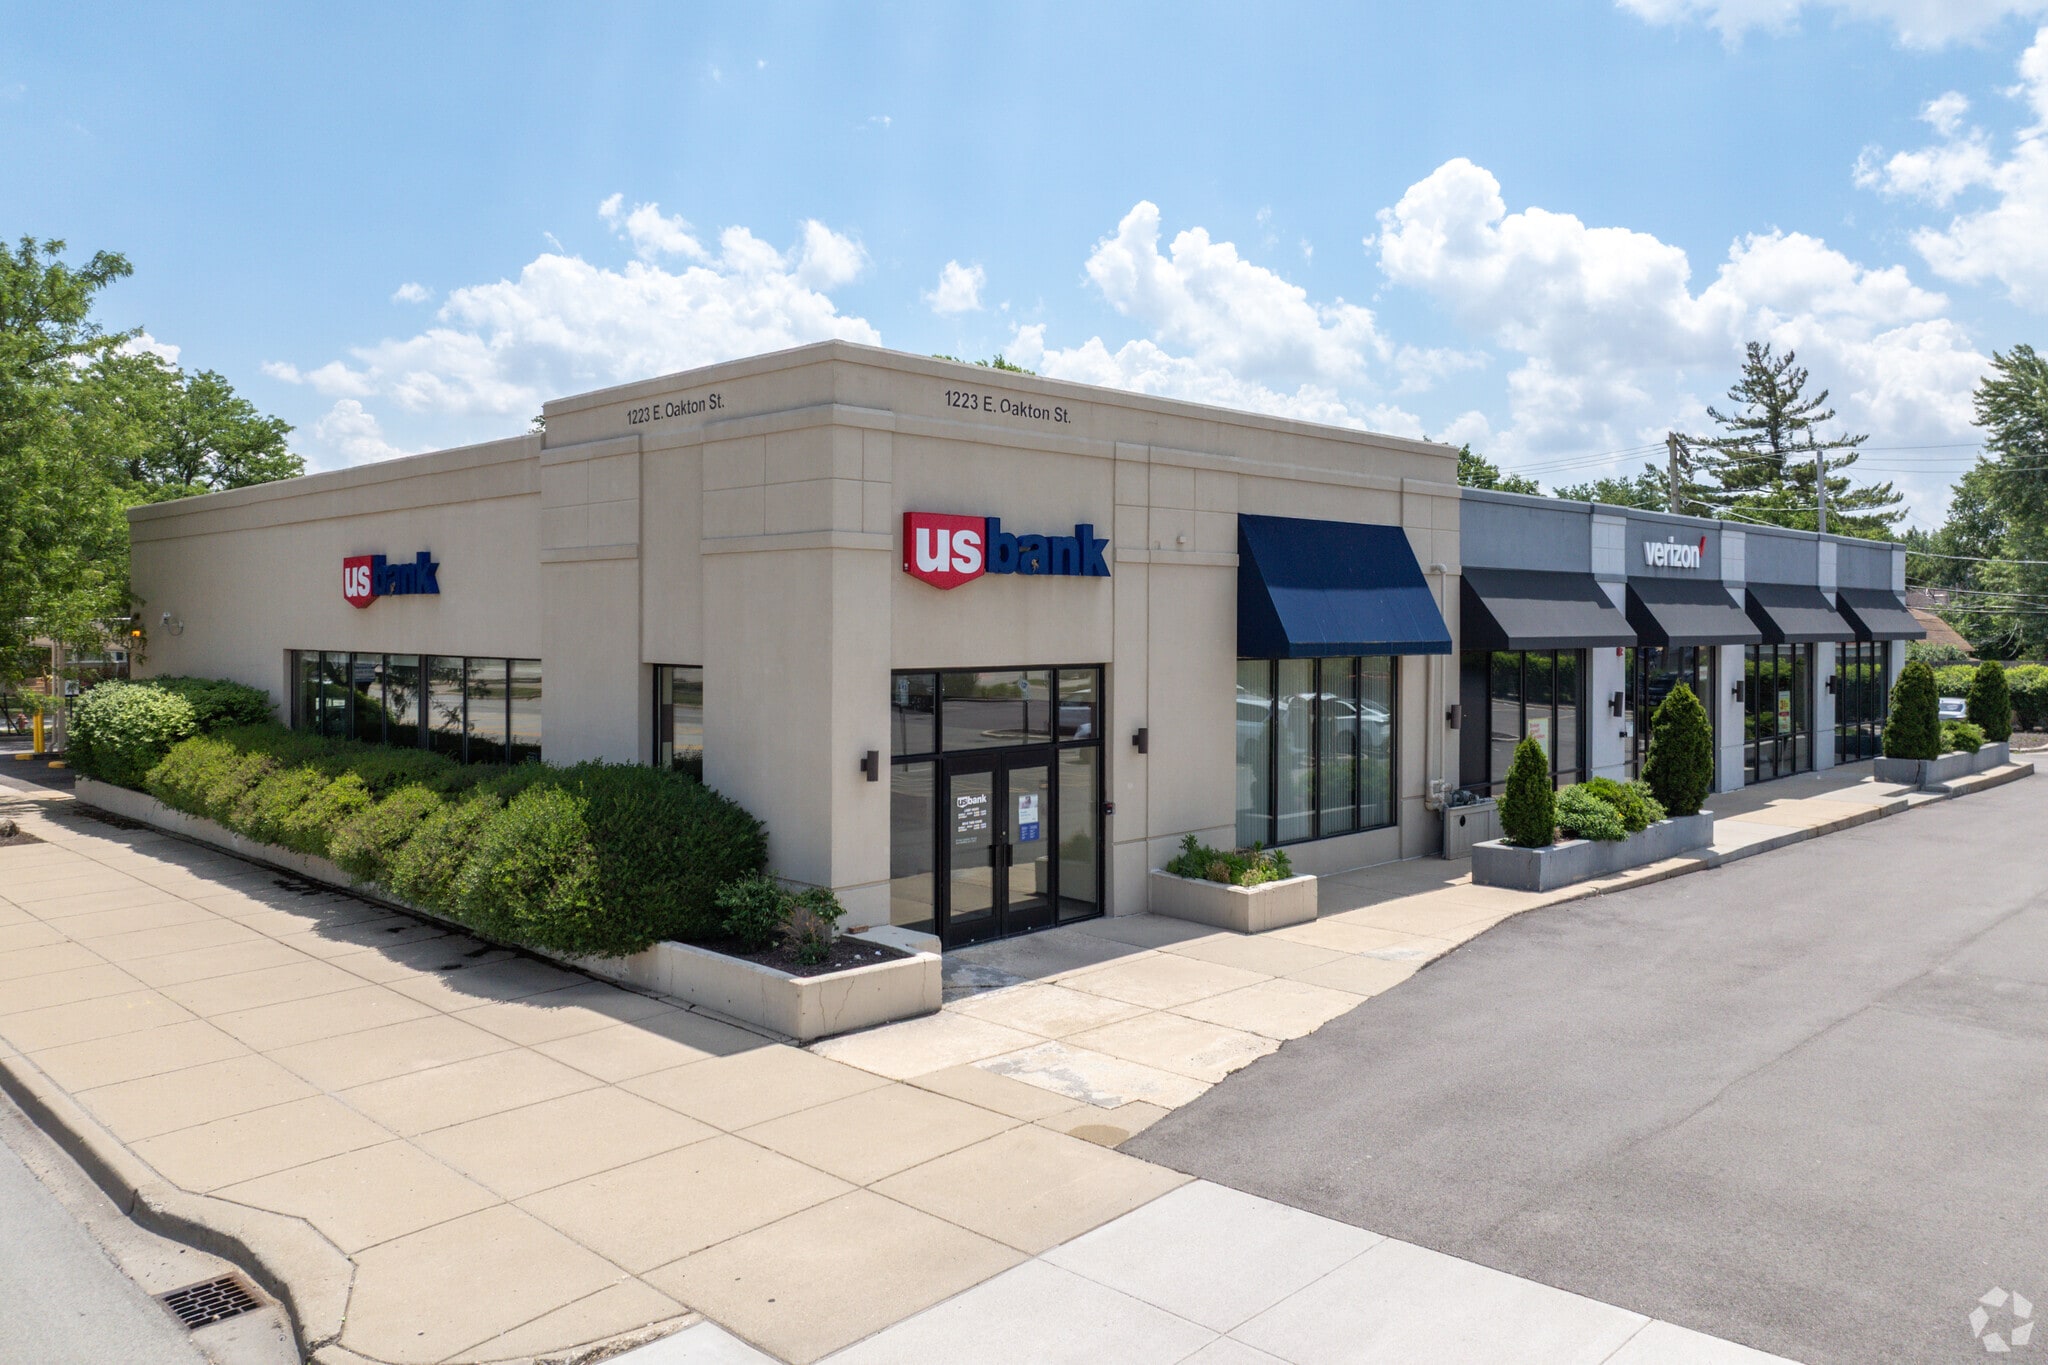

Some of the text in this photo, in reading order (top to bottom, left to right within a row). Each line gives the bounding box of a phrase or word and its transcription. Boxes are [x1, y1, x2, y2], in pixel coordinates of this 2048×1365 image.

[627, 393, 725, 425] 1223 E. Oakton St.
[945, 390, 1071, 424] 1223 E. Oakton St.
[1642, 535, 1700, 568] verizon
